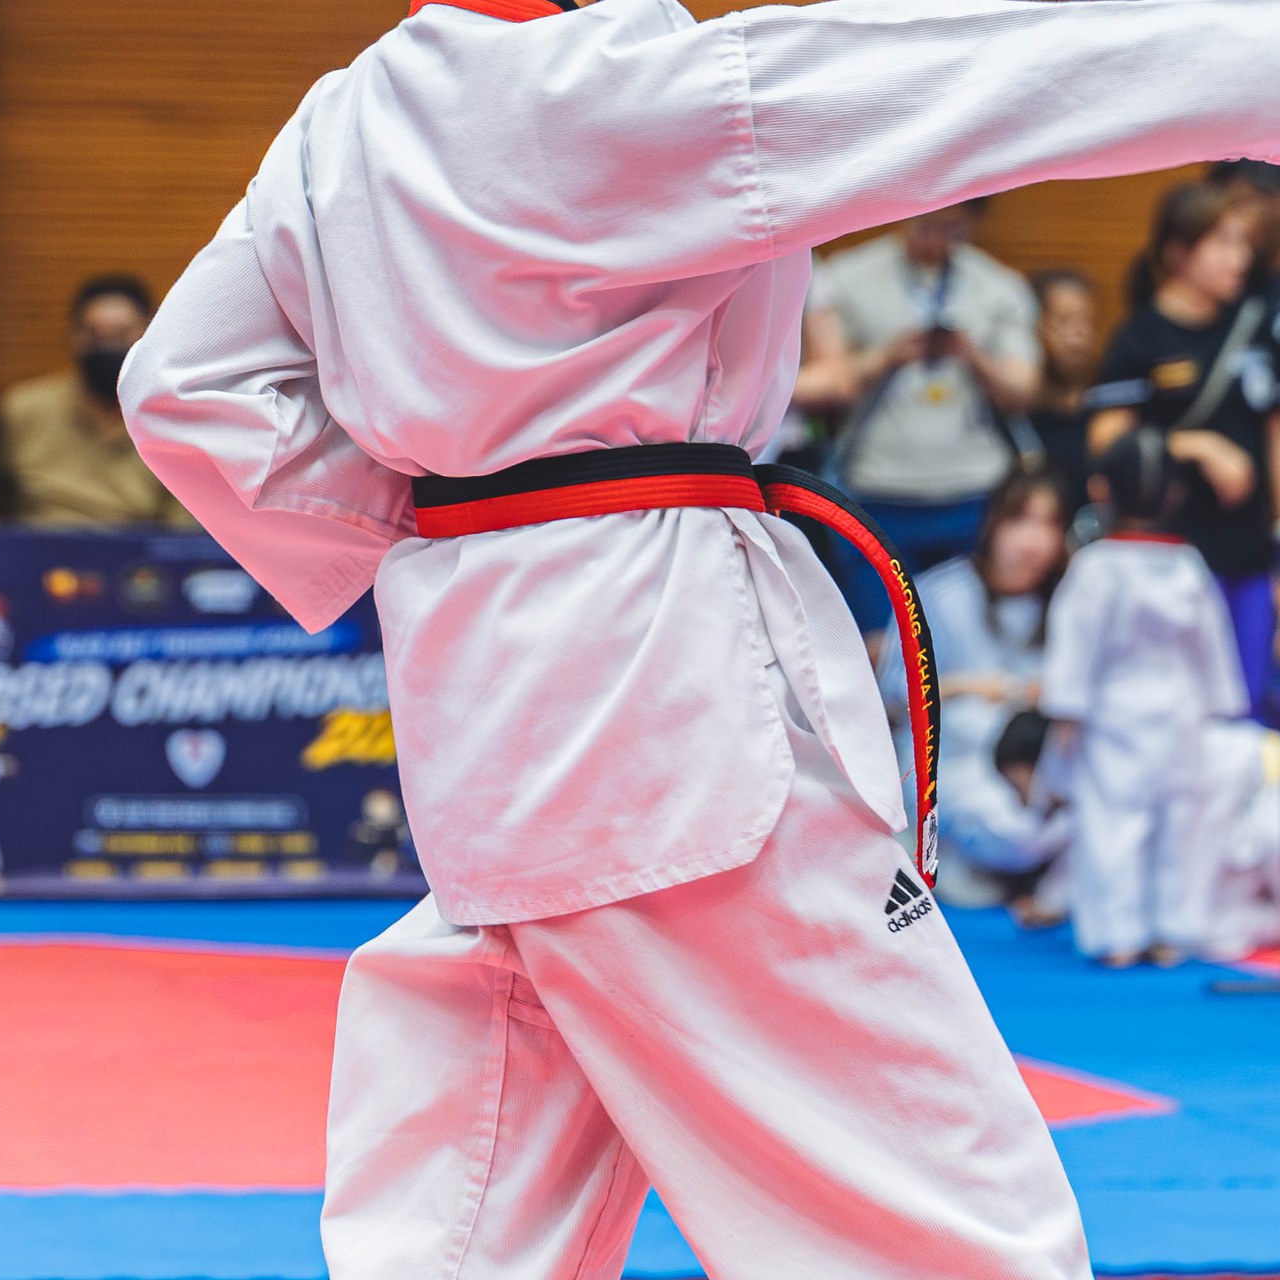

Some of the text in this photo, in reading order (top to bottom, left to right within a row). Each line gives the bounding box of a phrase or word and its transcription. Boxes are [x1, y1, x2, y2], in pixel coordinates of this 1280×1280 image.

[889, 558, 922, 639] CHONG
[916, 647, 933, 711] KHAI
[887, 897, 933, 933] adidas
